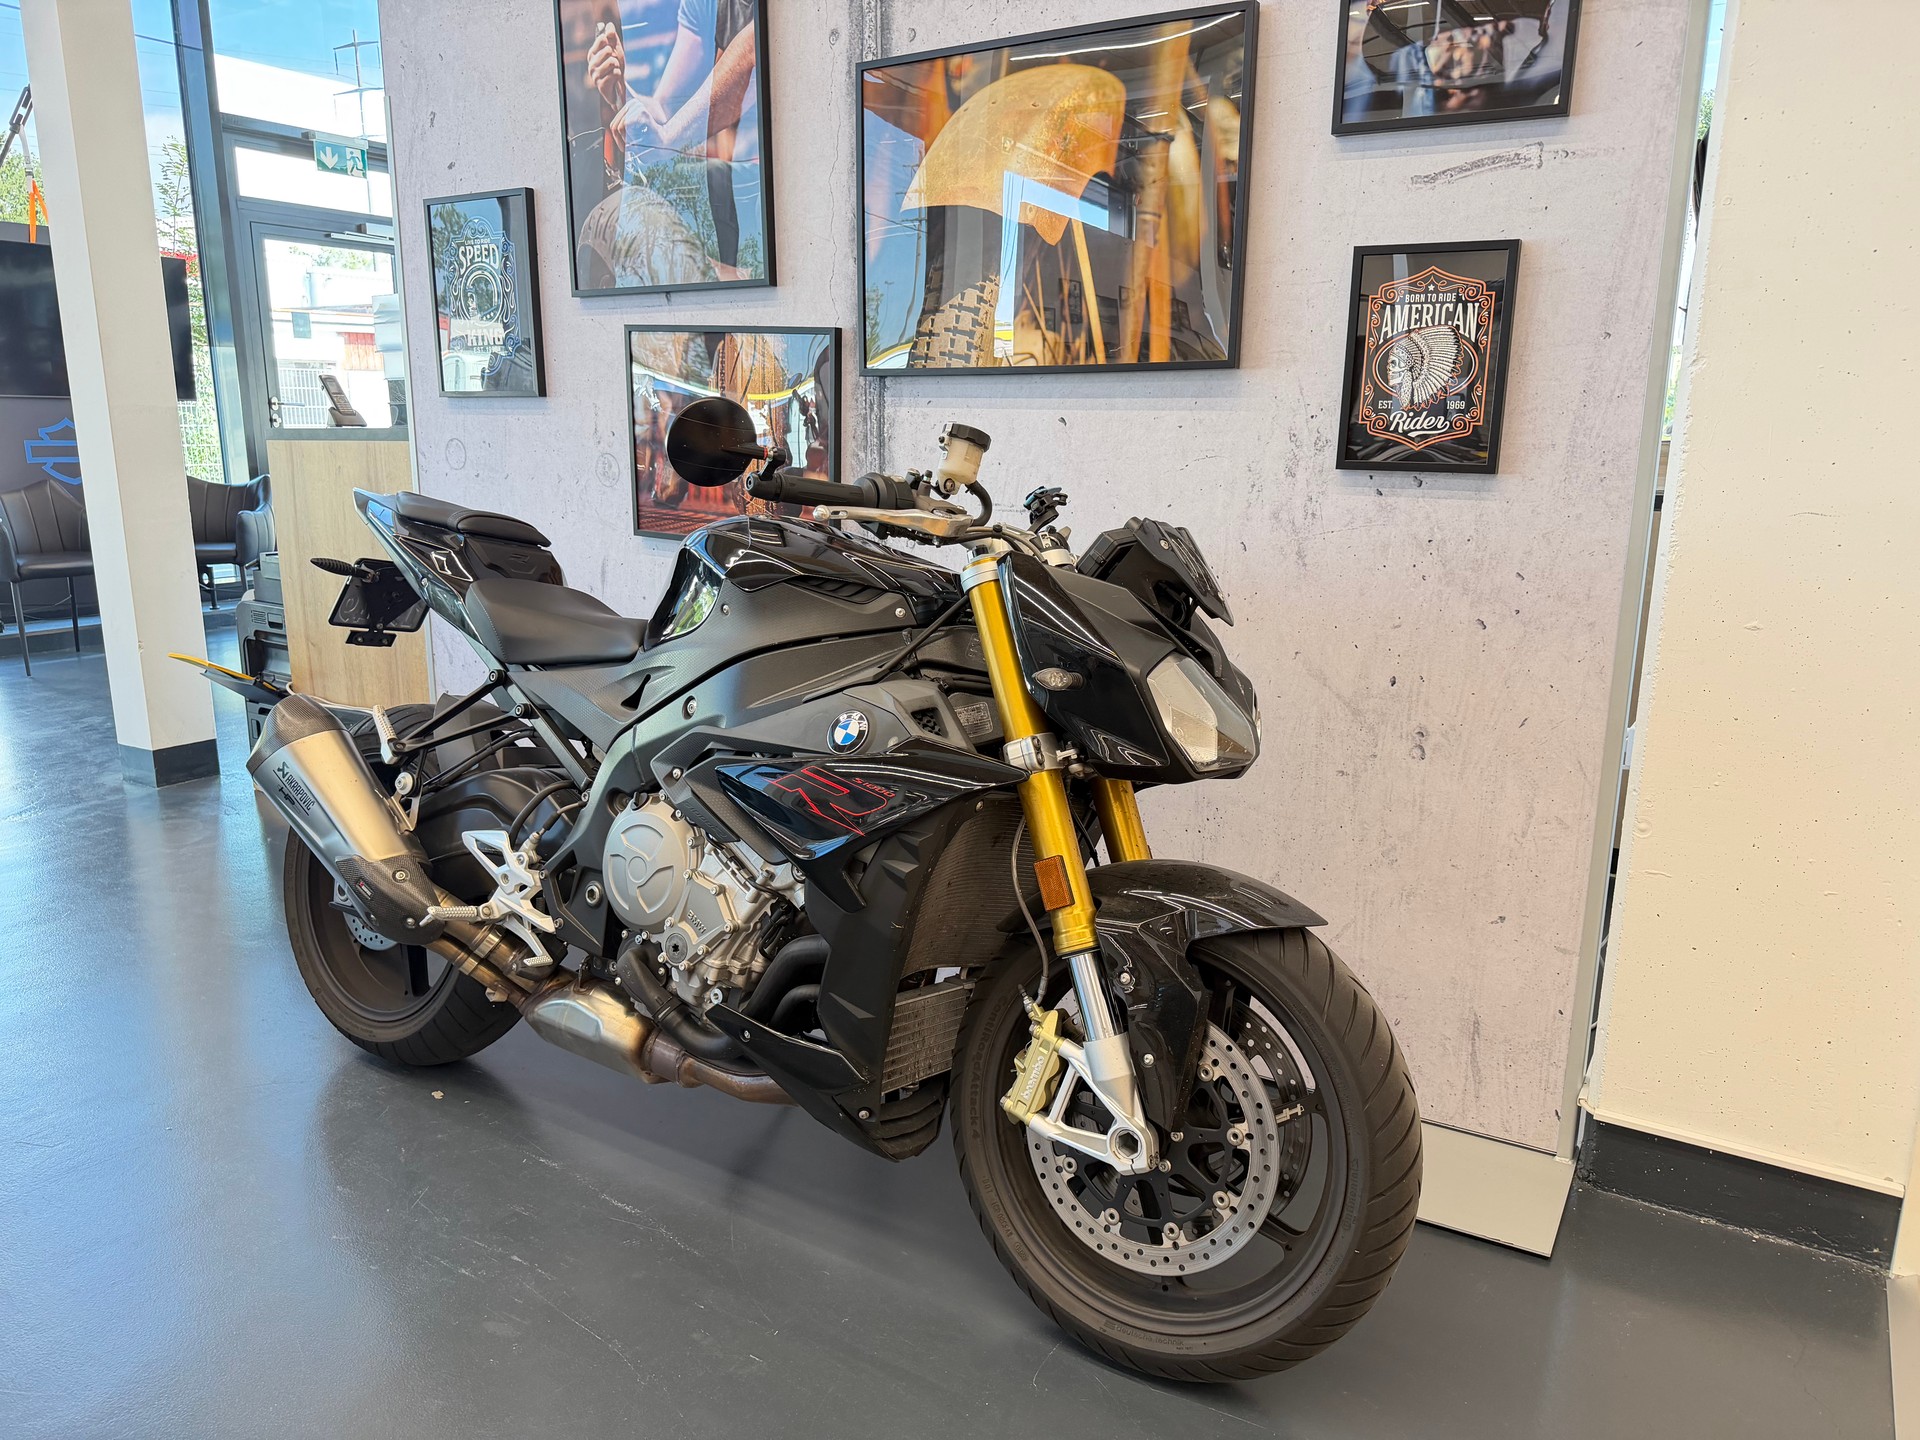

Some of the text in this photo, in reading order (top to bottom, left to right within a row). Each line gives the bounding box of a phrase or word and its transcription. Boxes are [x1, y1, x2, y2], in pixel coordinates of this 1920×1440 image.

[459, 243, 499, 275] SPEED
[1405, 293, 1457, 303] BORN TO RIDE
[1379, 302, 1480, 345] AMERICAN
[467, 328, 504, 347] KING
[1378, 400, 1465, 410] EST. 1969
[1389, 410, 1450, 437] Rider
[840, 712, 867, 731] BMW
[687, 909, 707, 934] BMW
[1021, 1055, 1045, 1100] brembo
